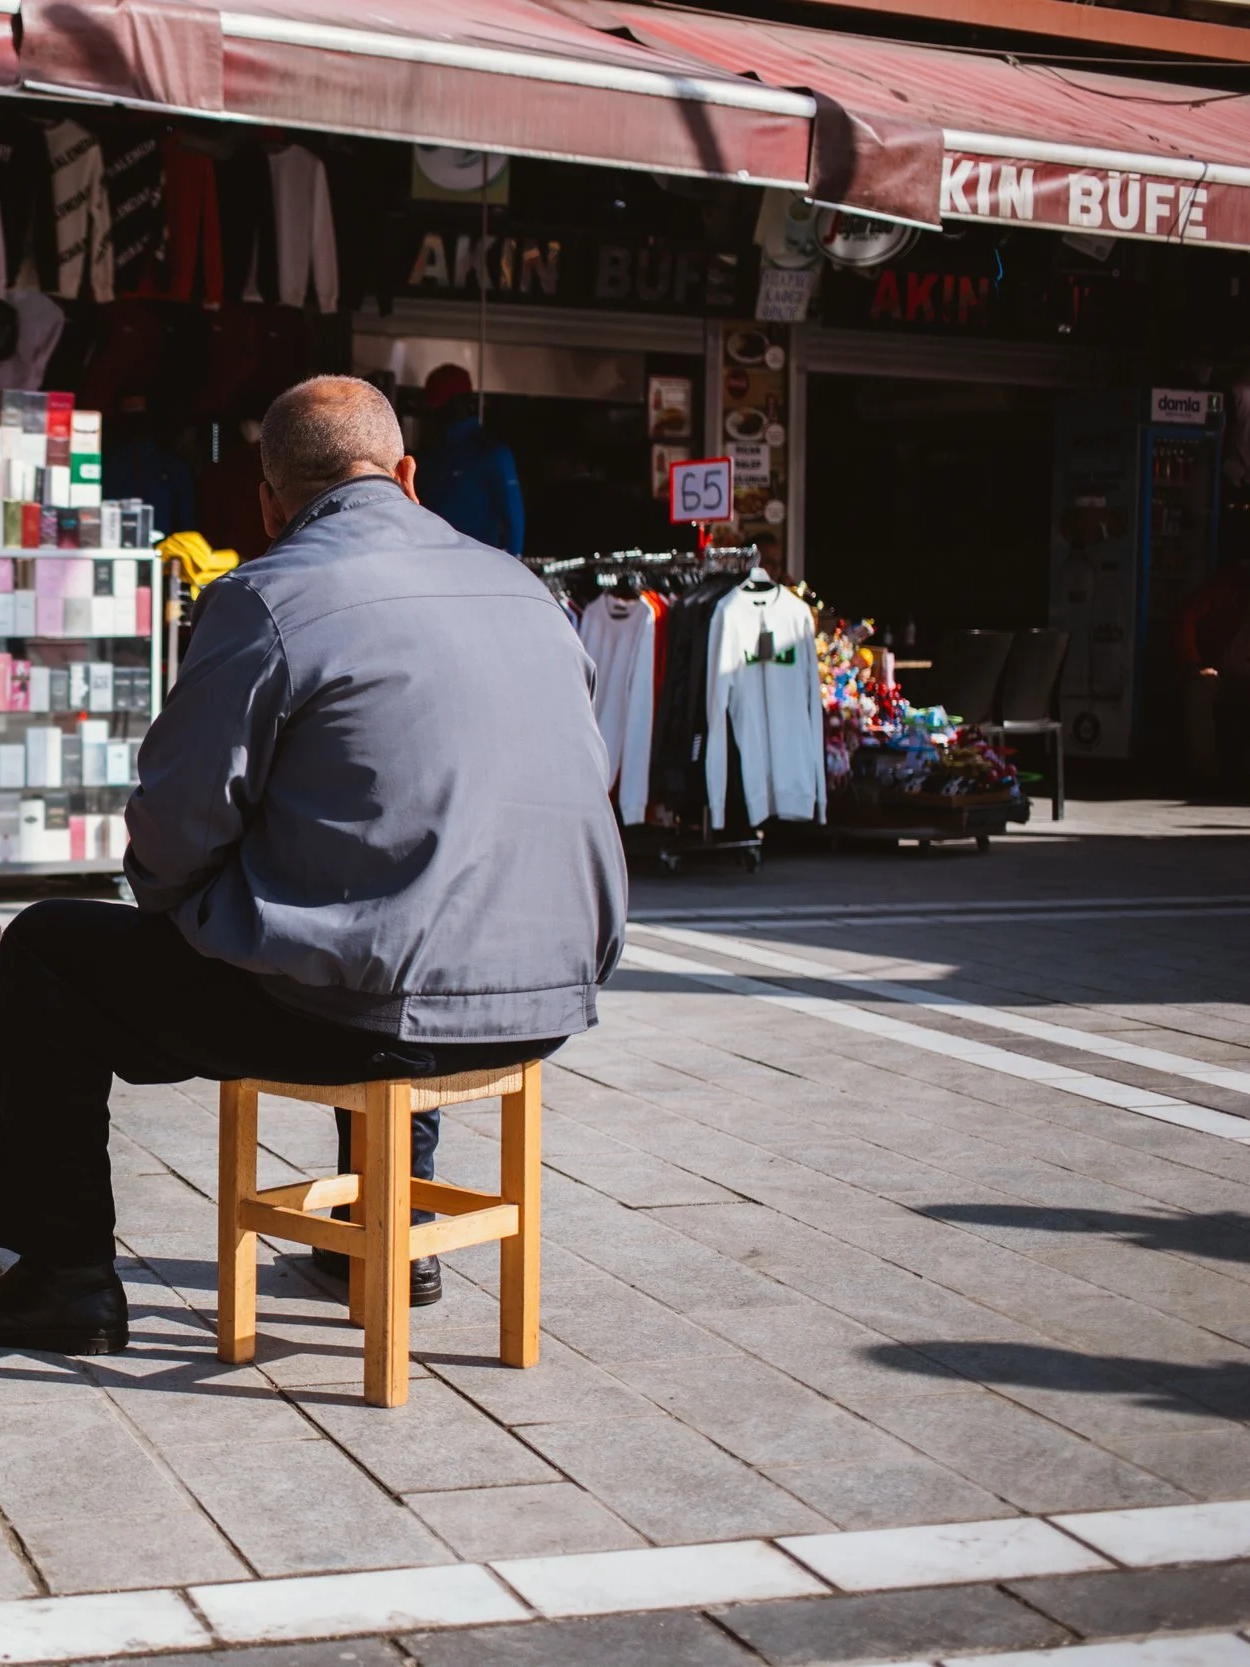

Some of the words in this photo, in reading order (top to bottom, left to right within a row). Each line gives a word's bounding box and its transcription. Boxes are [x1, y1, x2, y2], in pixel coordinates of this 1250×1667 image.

[1068, 171, 1208, 239] BÜFE
[407, 231, 562, 295] AKIN
[596, 235, 738, 307] BÜFE
[869, 269, 989, 327] AKIN
[1158, 395, 1200, 413] damla
[681, 469, 723, 512] 65
